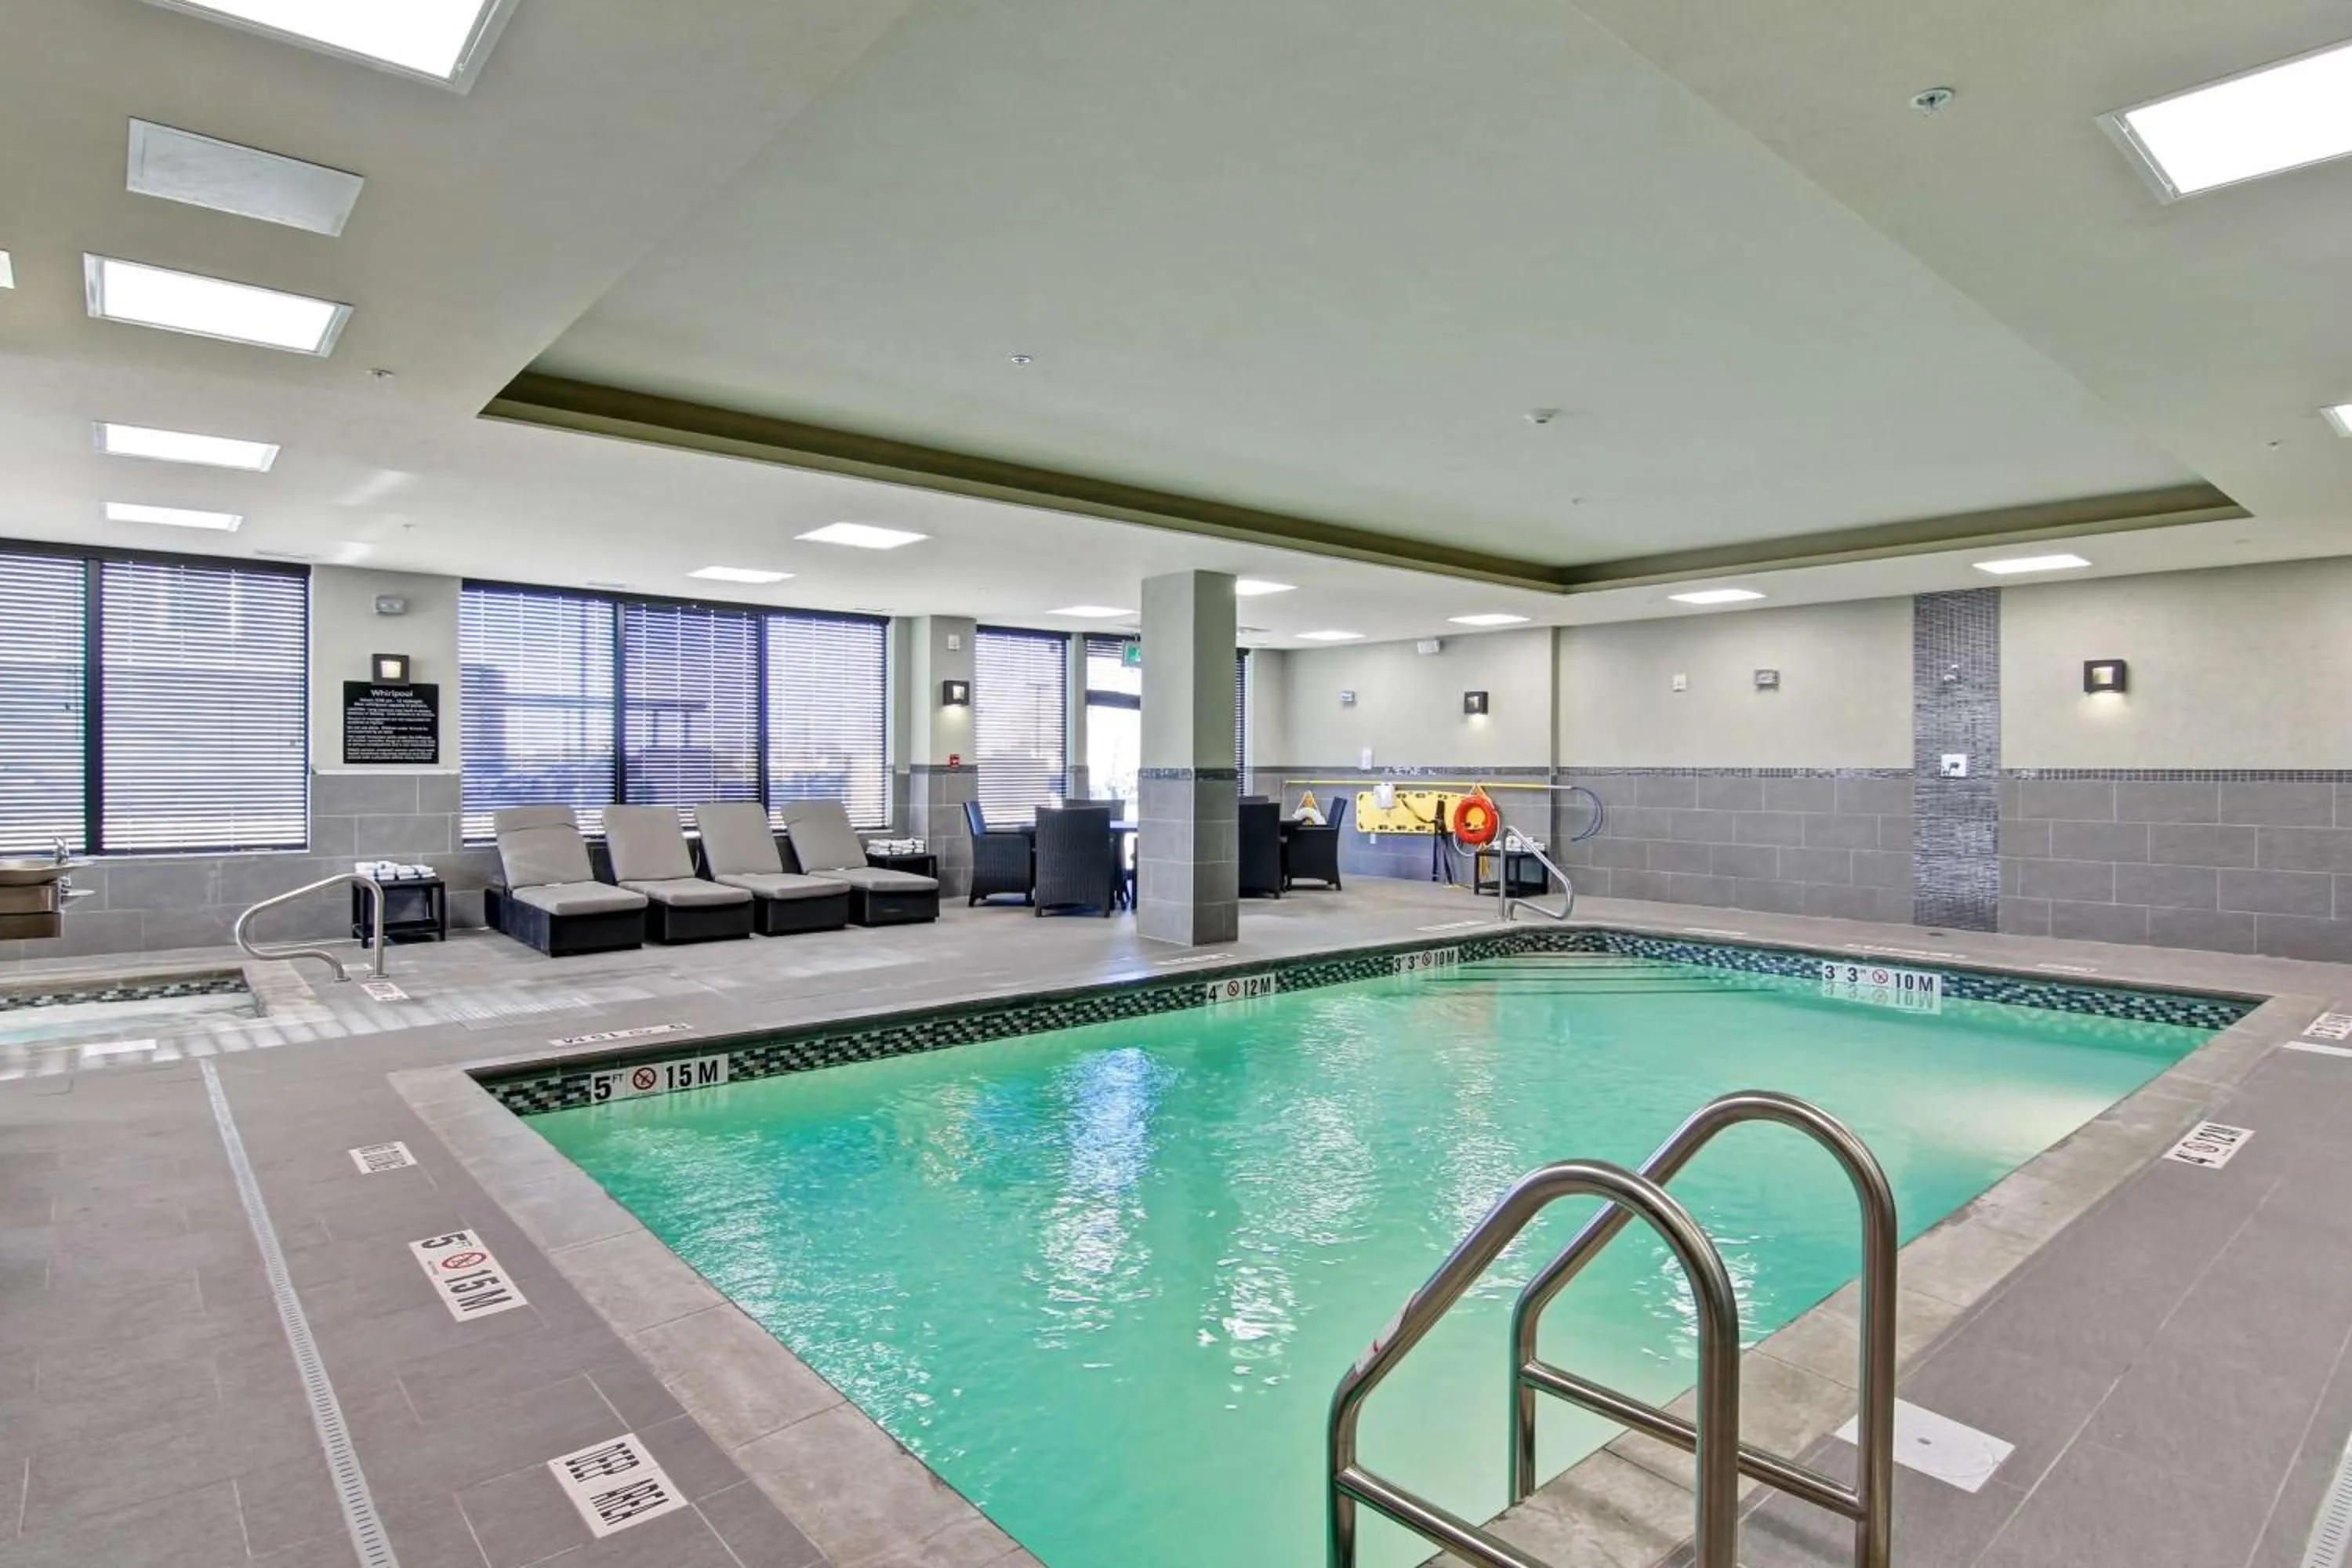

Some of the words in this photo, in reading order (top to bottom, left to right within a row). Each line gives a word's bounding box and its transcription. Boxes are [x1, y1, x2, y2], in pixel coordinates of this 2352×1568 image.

[370, 689, 414, 698] Whirlpool
[564, 1442, 641, 1483] DEEP
[589, 1478, 670, 1526] AREA
